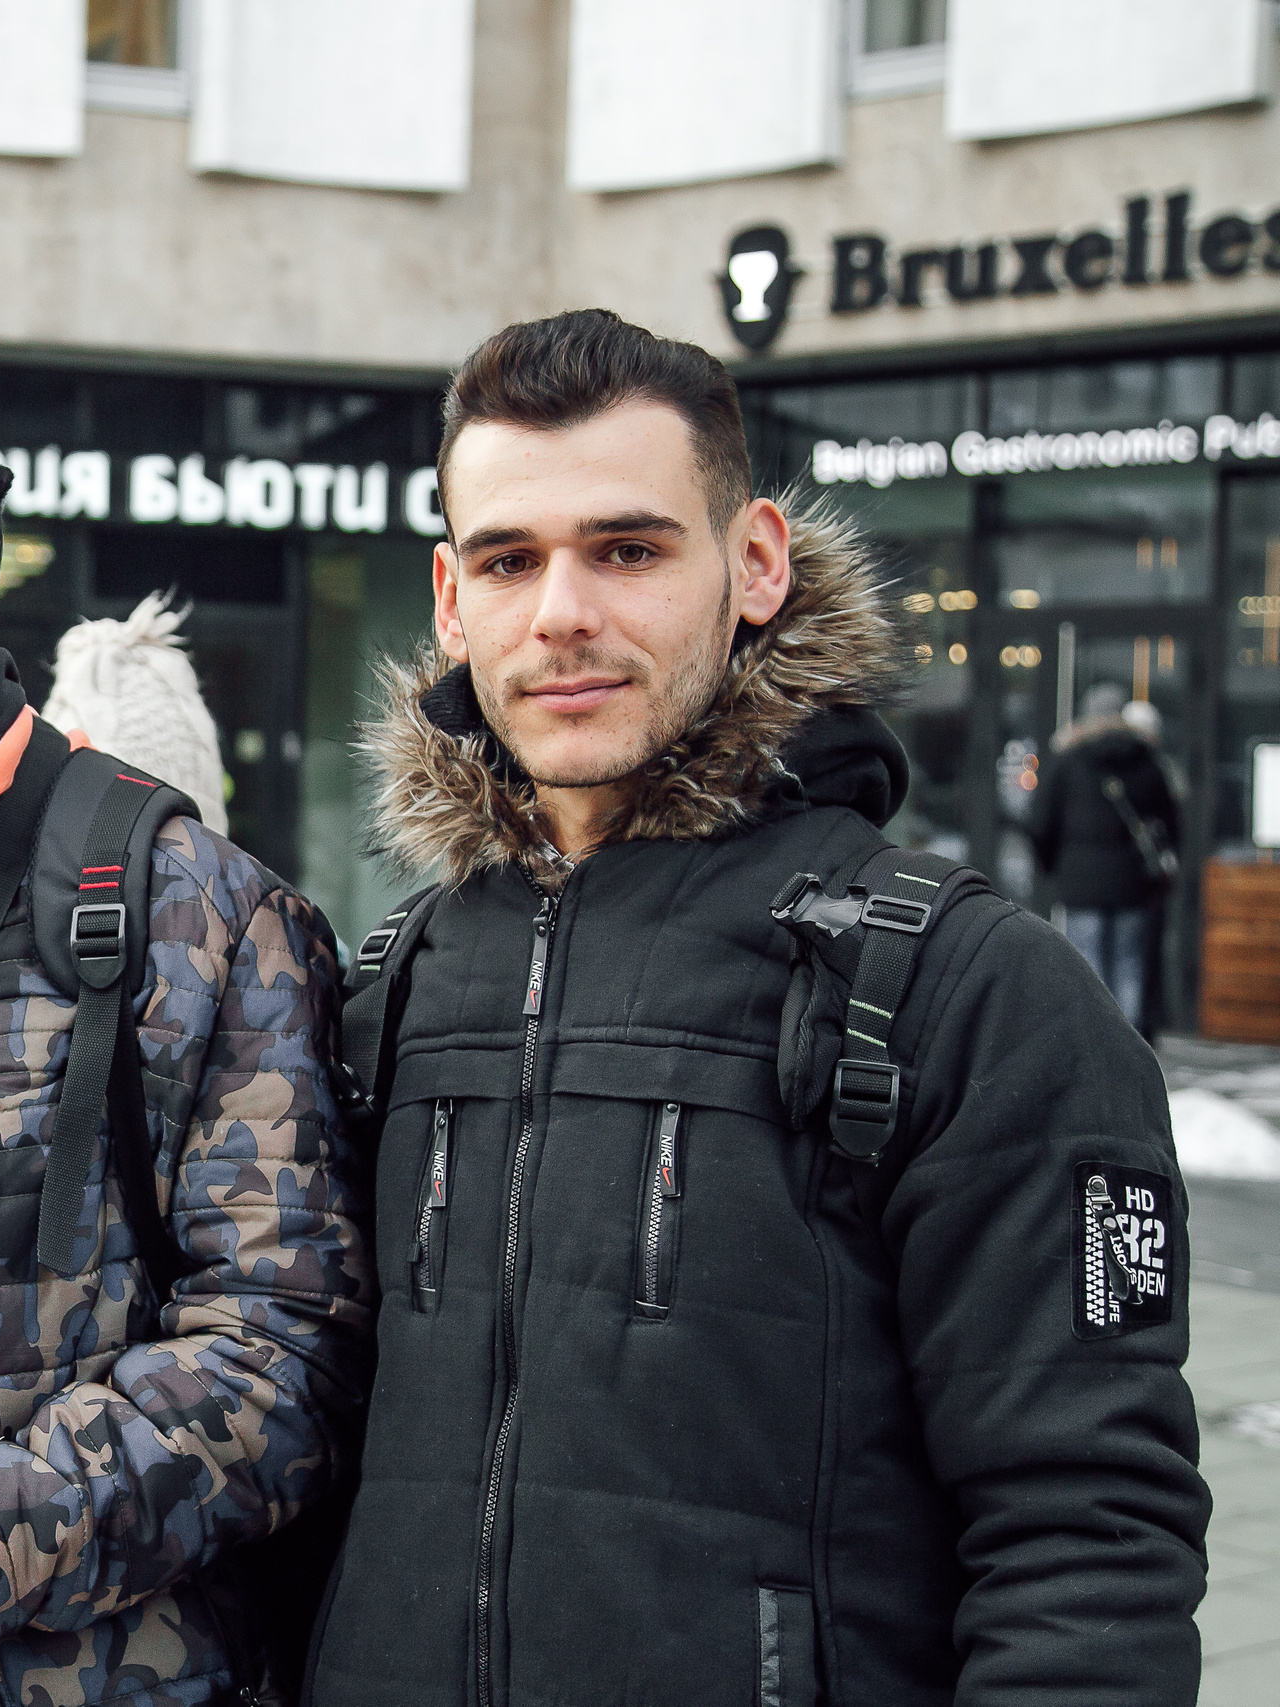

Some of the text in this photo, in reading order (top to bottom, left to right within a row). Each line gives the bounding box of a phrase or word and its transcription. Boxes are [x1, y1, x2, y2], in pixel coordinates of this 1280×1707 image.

[812, 436, 948, 489] Belgian
[951, 419, 1198, 476] Gastronomic
[529, 960, 543, 991] NIKE
[433, 1150, 445, 1181] NIKE
[660, 1134, 673, 1168] NIKE
[1125, 1186, 1154, 1212] HD
